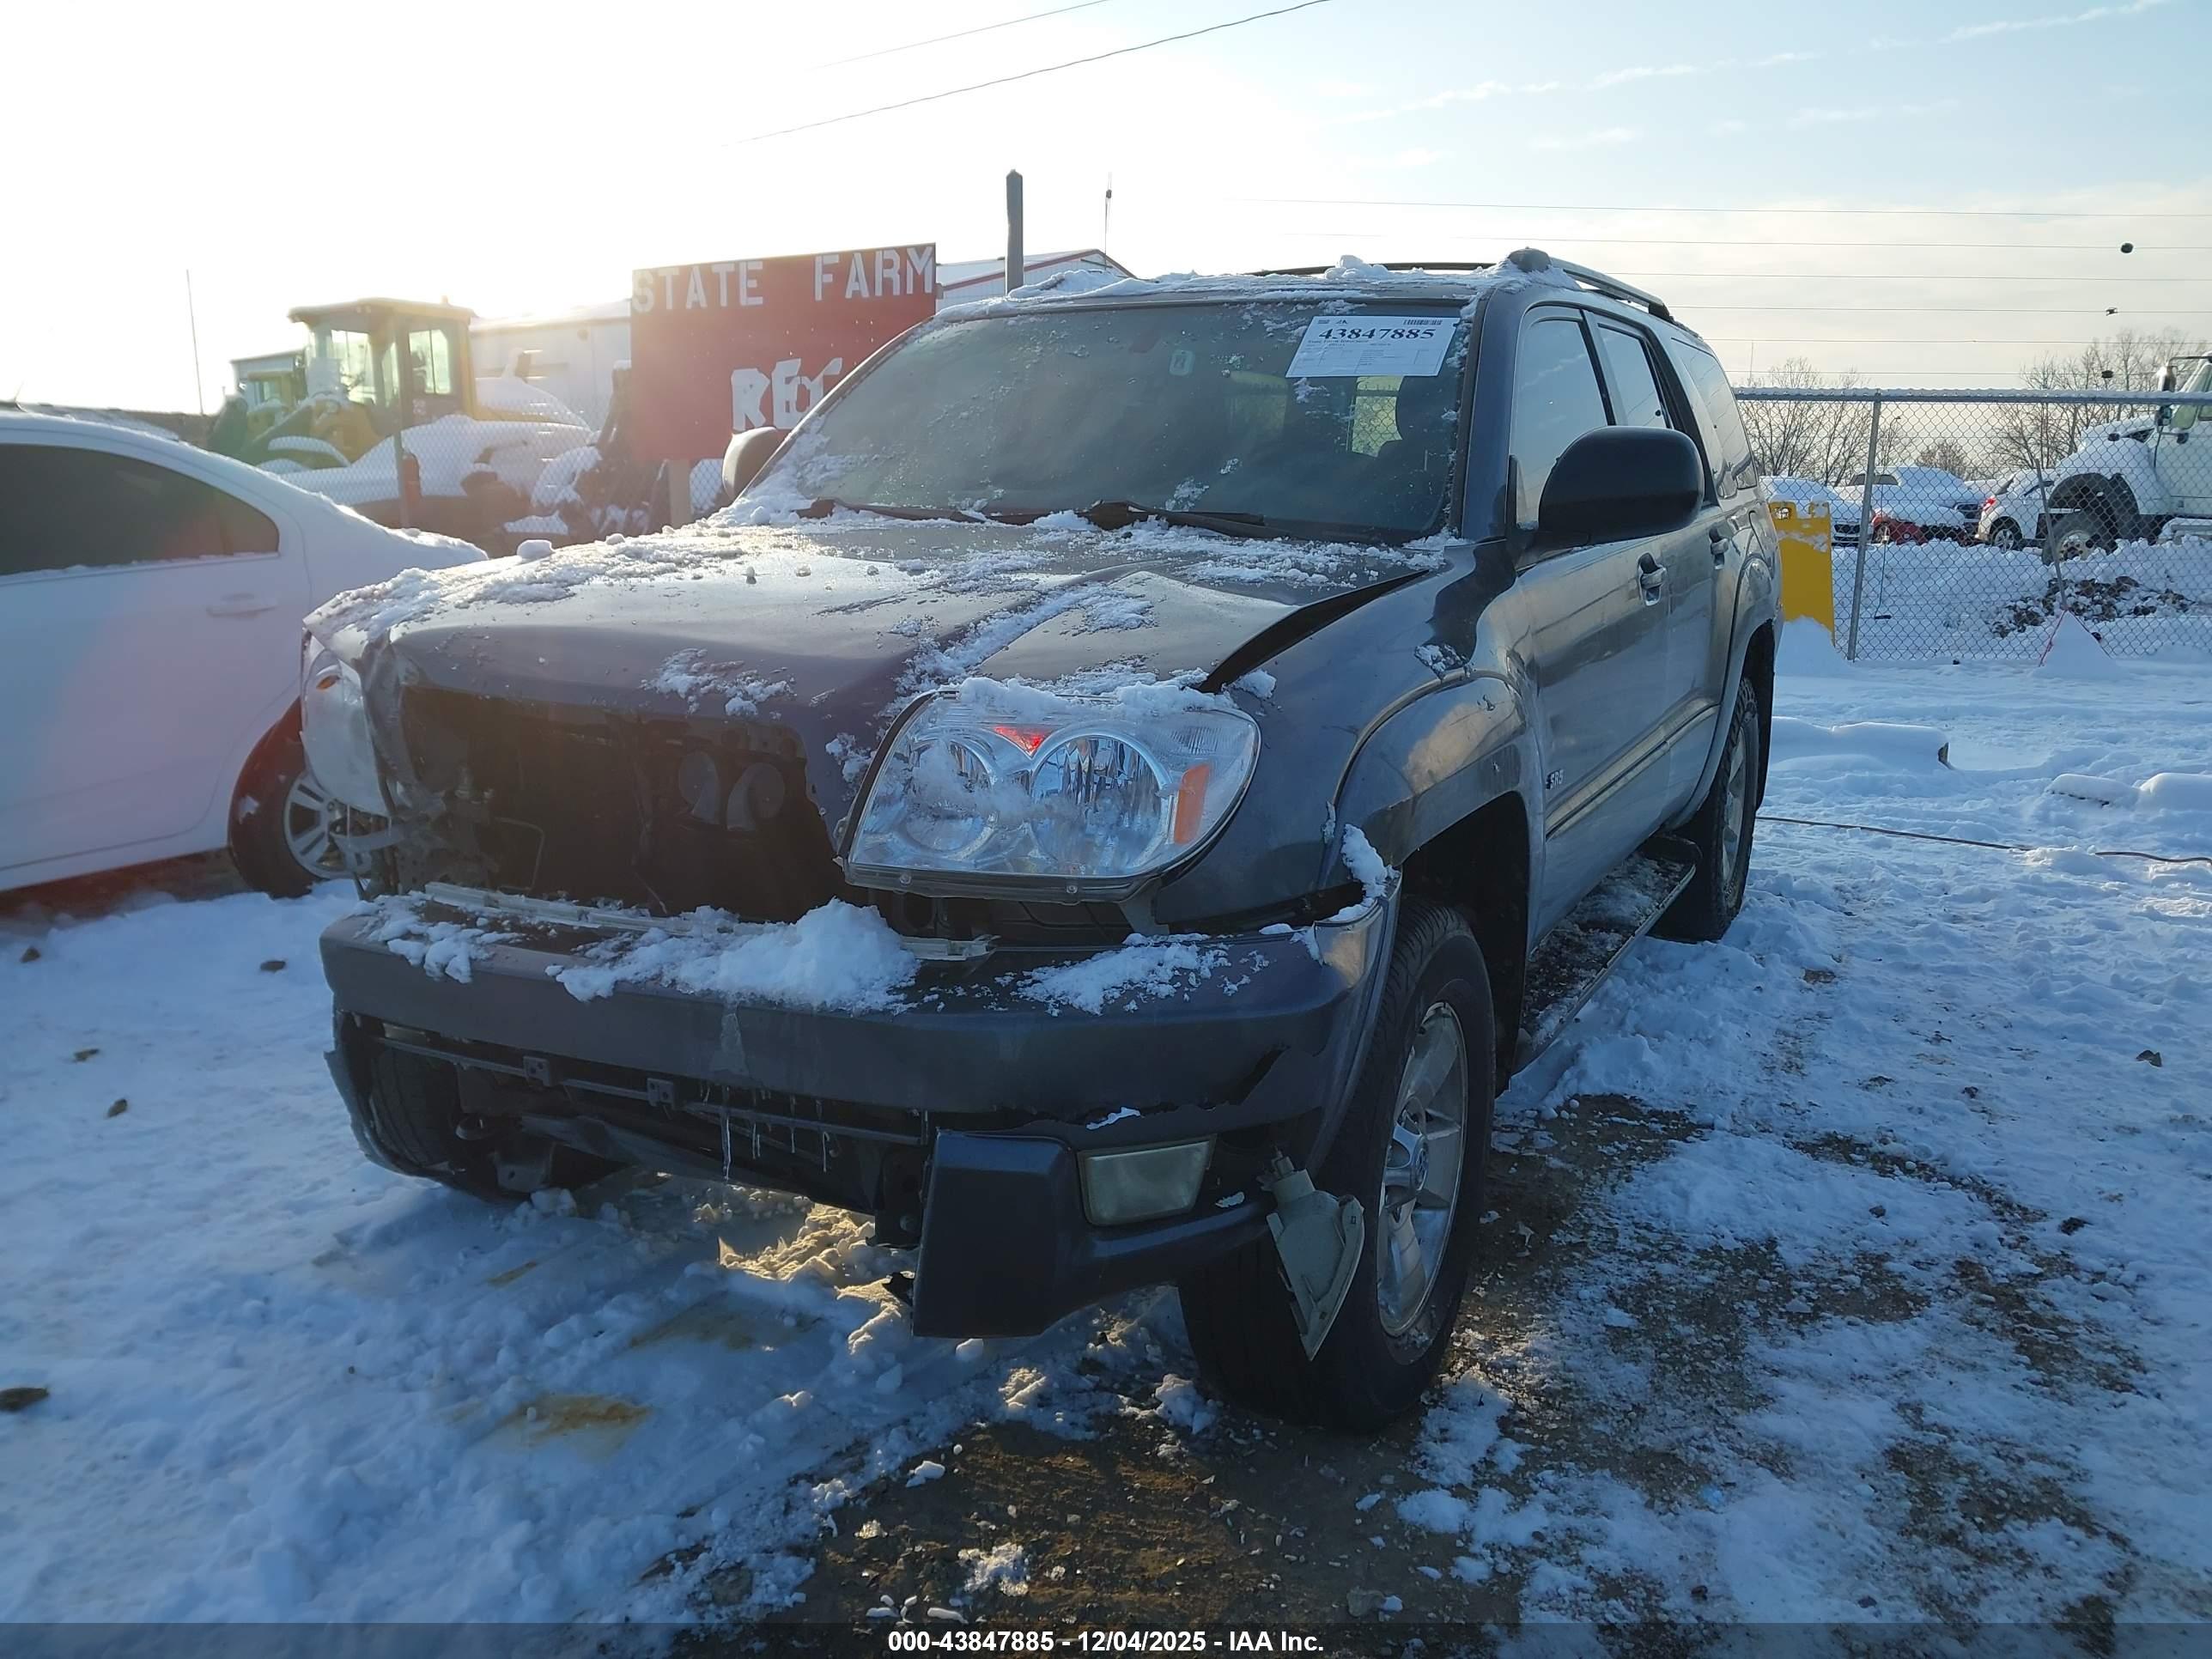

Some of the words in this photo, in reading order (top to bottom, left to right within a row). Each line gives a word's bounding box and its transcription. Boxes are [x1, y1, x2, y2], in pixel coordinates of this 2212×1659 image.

[632, 260, 764, 313] STATE
[813, 246, 934, 301] FARM
[1318, 328, 1435, 339] 43847885
